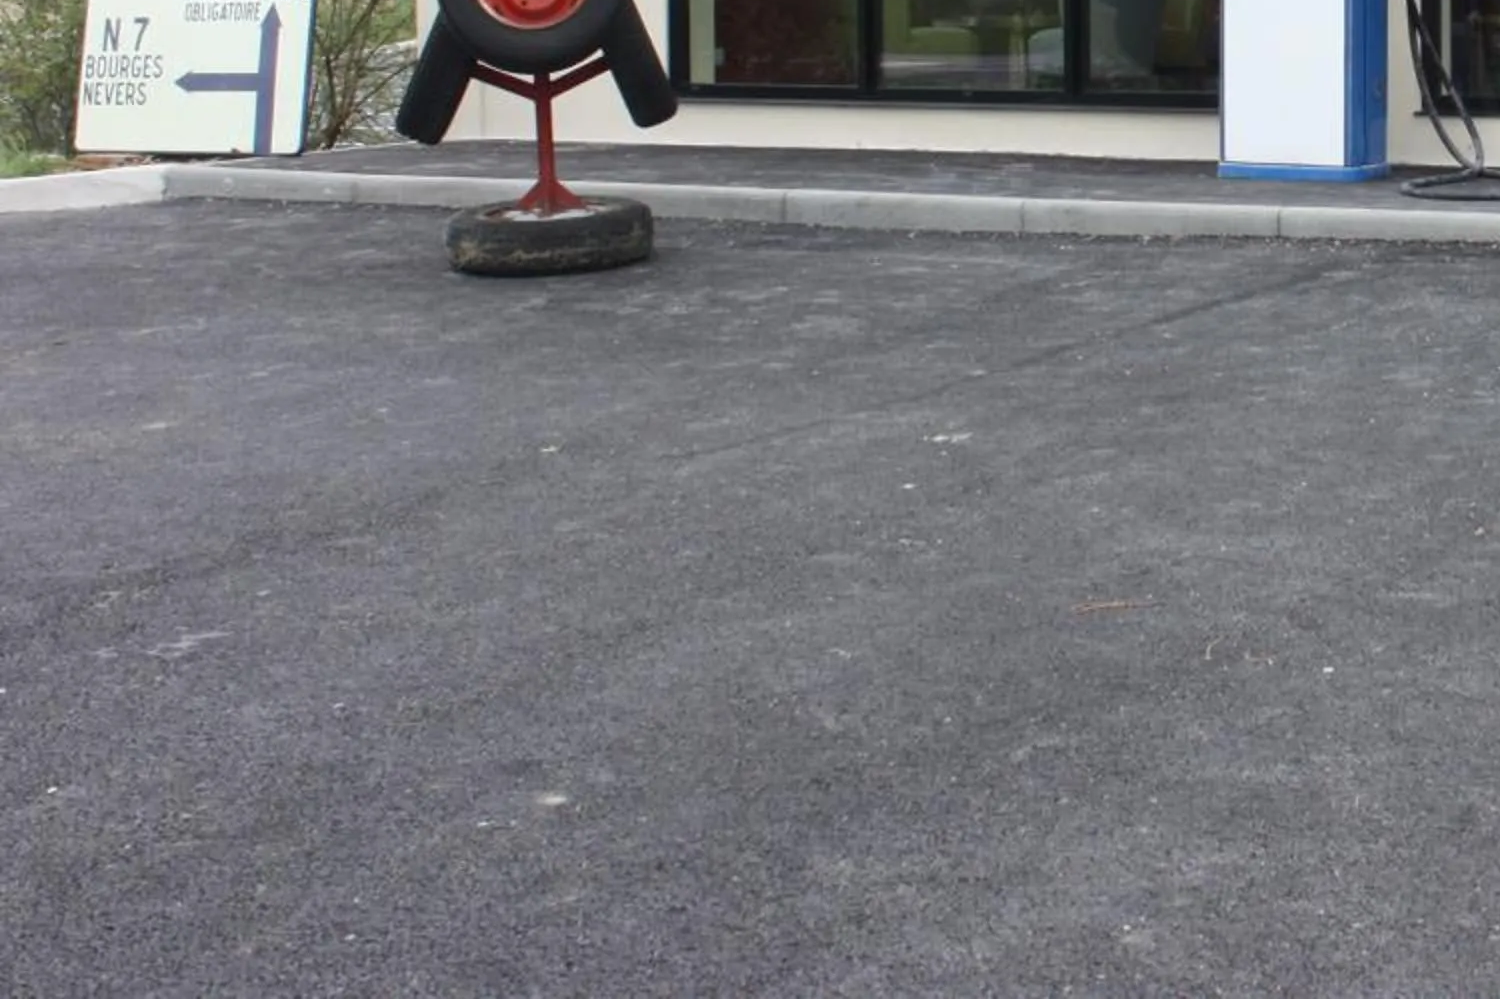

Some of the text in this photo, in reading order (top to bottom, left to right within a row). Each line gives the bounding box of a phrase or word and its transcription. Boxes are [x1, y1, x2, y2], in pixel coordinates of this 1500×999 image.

[184, 1, 262, 23] OBLIGATOIRE
[102, 17, 150, 52] N 7
[85, 54, 163, 79] BOURGES
[83, 82, 147, 106] NEVERS
